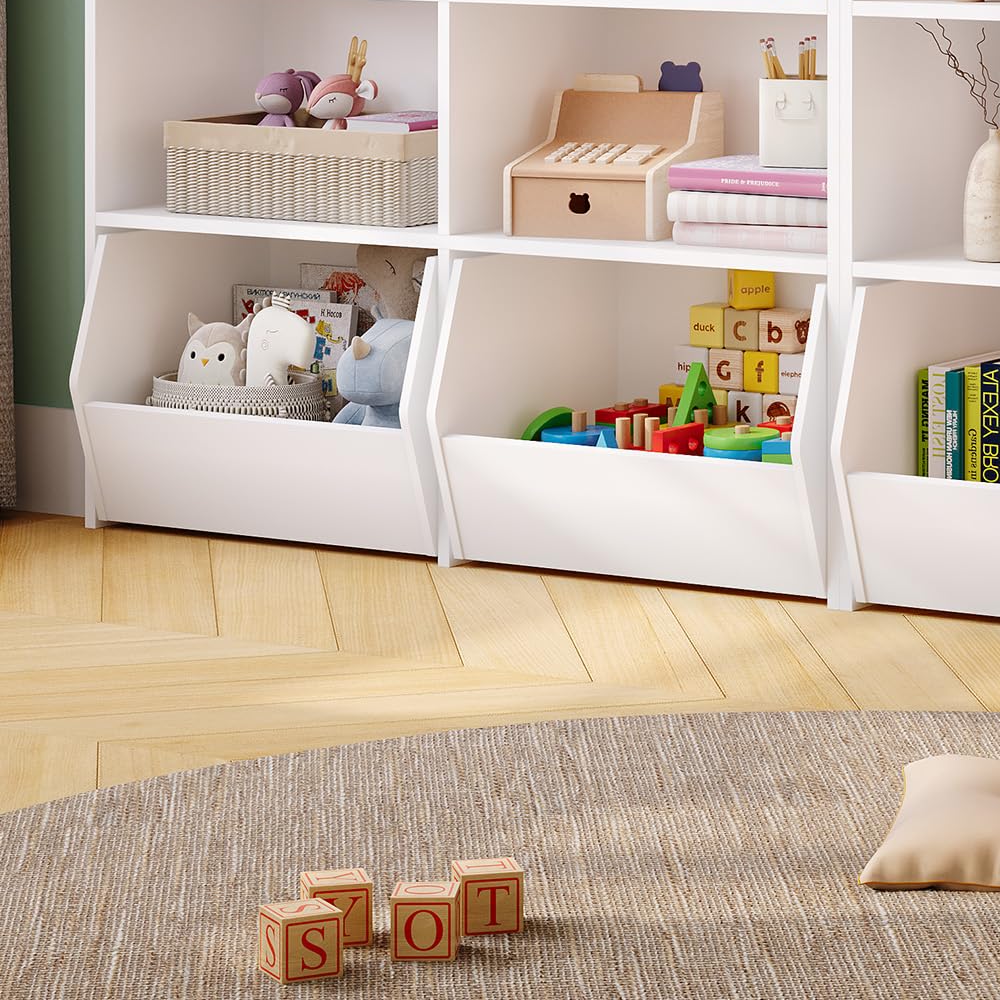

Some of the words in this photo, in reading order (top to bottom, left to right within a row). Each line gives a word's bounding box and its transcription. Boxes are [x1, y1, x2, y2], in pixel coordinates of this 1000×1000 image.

[741, 285, 770, 295] apple
[693, 322, 715, 332] duck
[767, 320, 783, 343] b
[716, 360, 731, 381] G
[755, 360, 765, 383] f
[736, 400, 751, 423] k
[327, 896, 362, 937] Y
[477, 885, 510, 927] T
[404, 909, 444, 951] O
[301, 926, 328, 972] S
